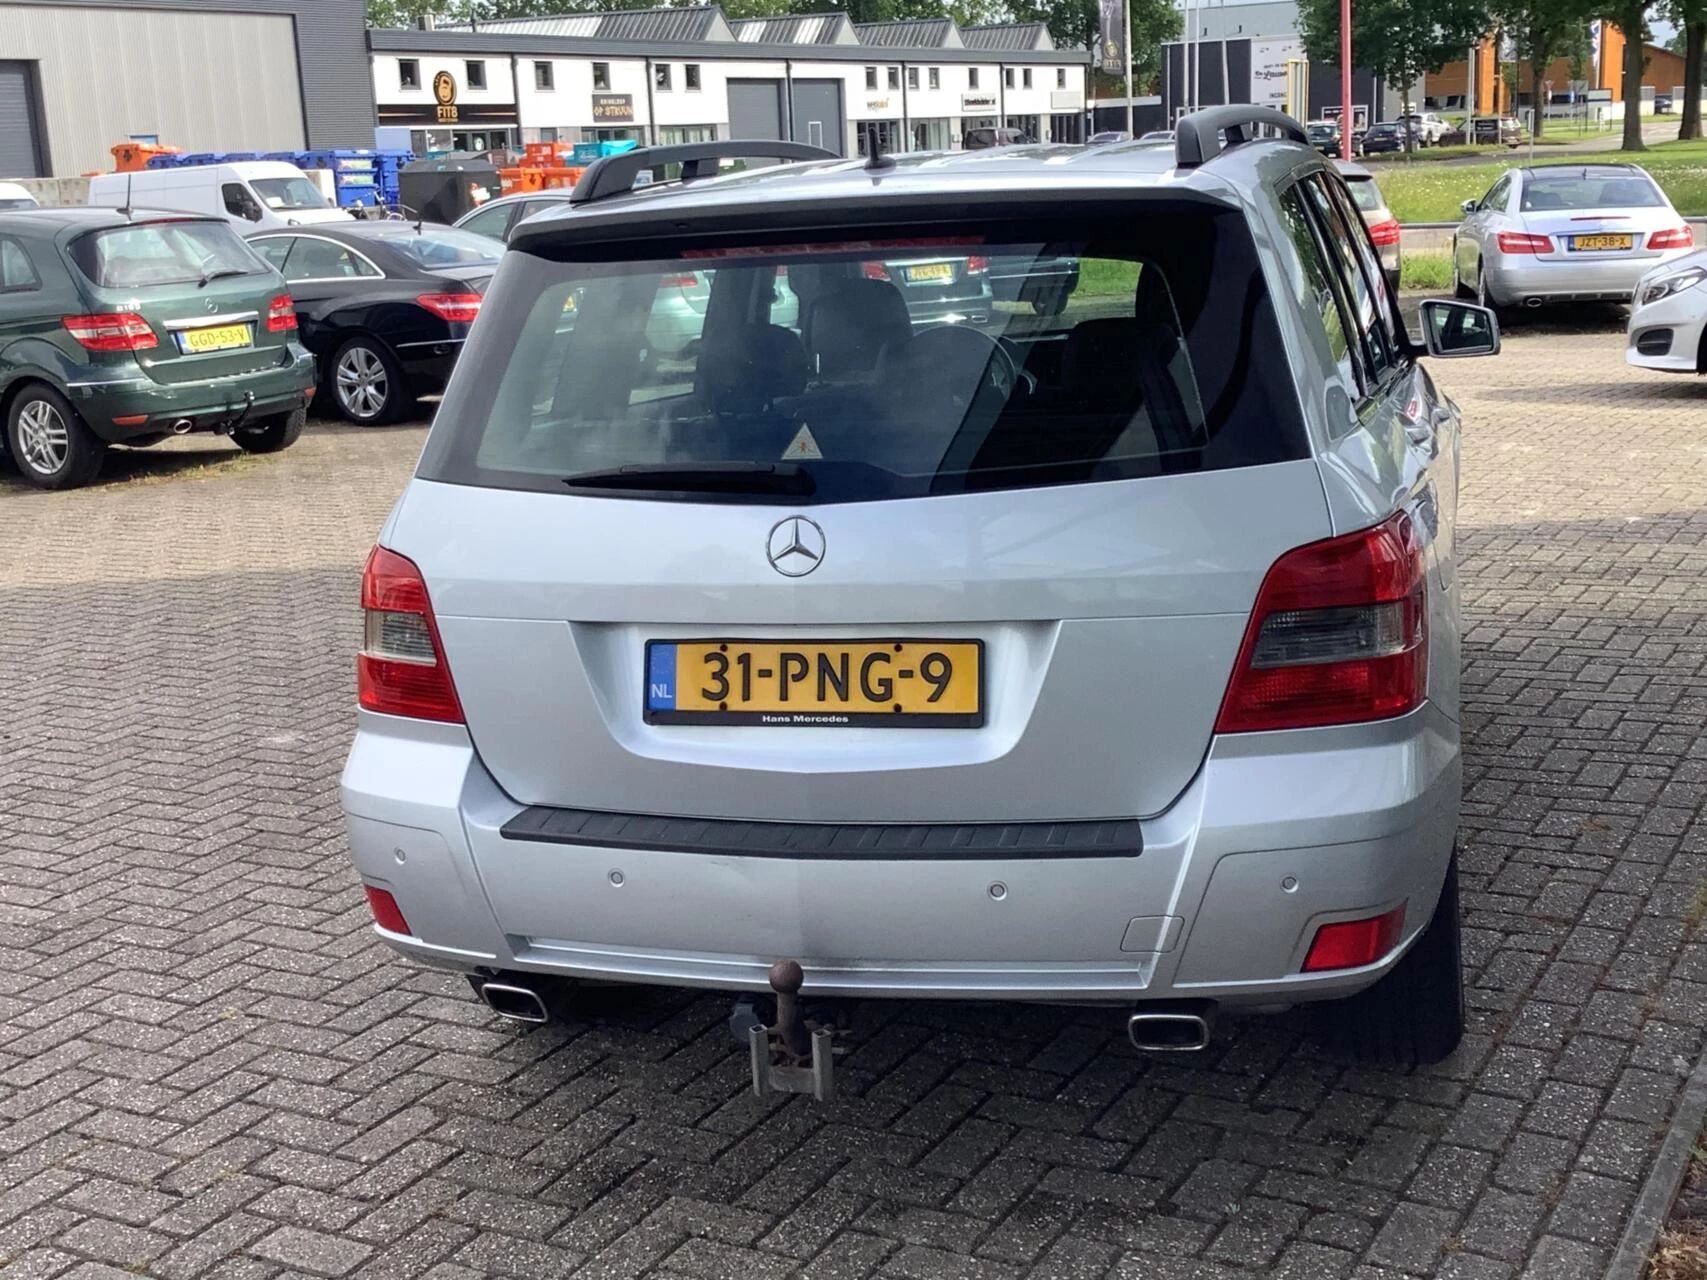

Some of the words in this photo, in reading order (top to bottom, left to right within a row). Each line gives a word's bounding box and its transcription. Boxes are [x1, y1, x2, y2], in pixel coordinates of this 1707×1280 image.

[702, 651, 953, 703] 31-PNG-9
[651, 683, 673, 699] NL
[762, 714, 791, 723] Hans
[793, 714, 849, 723] Mercedes
